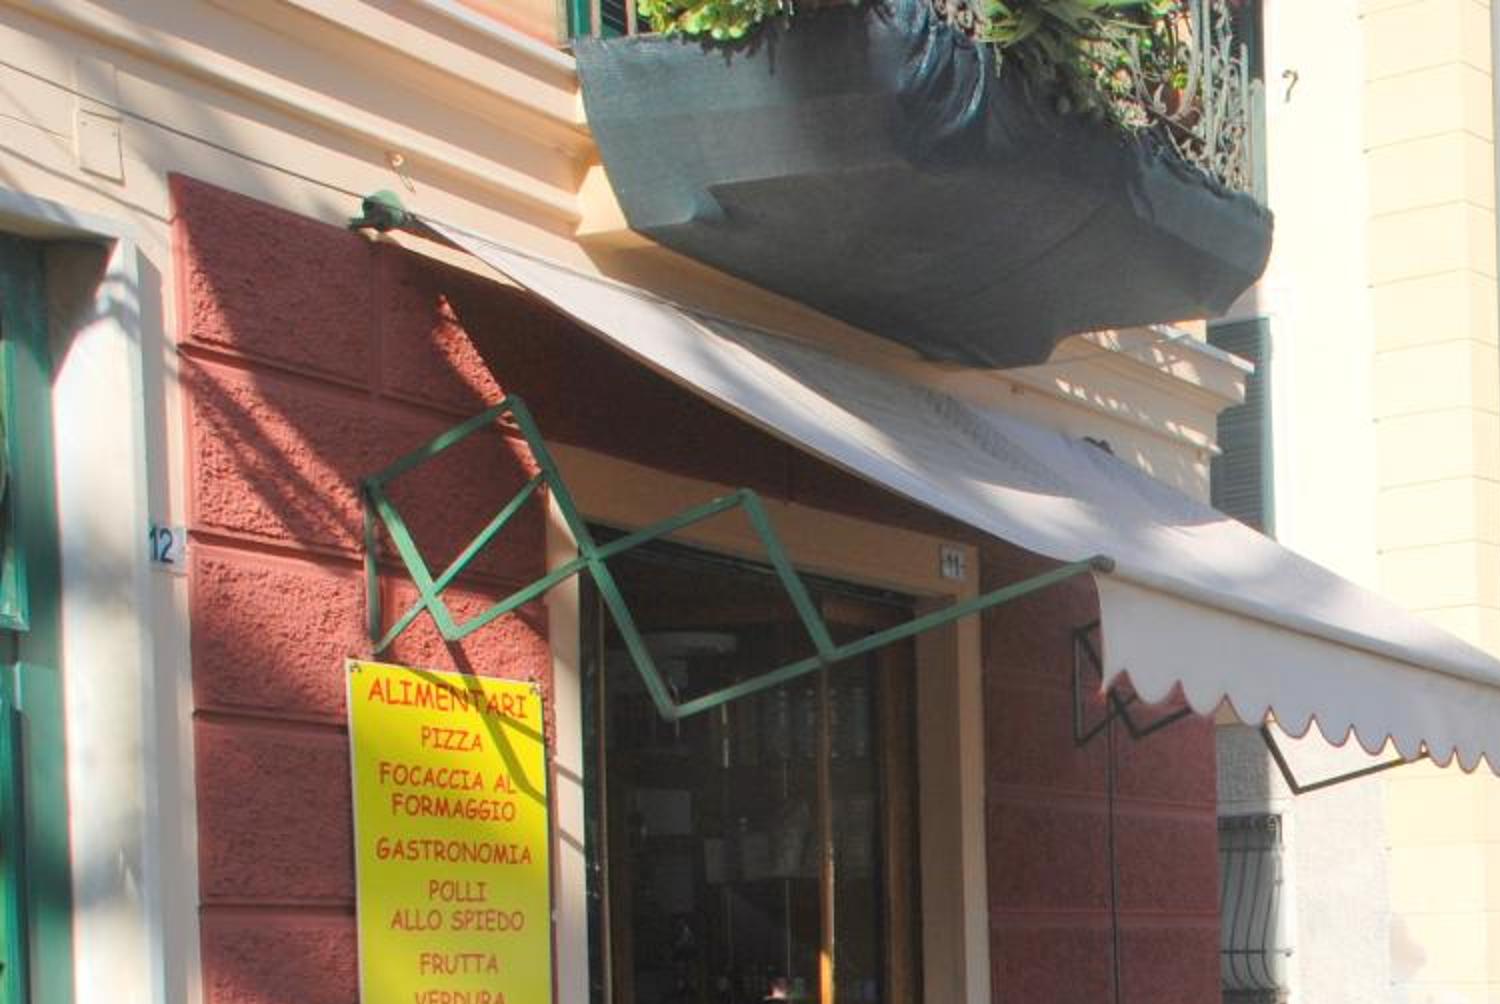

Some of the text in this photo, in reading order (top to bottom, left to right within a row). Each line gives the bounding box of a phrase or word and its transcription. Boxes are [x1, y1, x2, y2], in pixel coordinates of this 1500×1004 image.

[149, 526, 174, 564] 12
[368, 677, 528, 719] ALIMENTARI
[421, 725, 483, 752] PIZZA
[378, 762, 517, 795] FOCACCIA AL
[391, 793, 516, 822] FORMAGGIO
[376, 837, 532, 865] GASTRONOMIA
[429, 879, 488, 903] POLLI
[390, 908, 525, 932] ALLO SPIEDO
[419, 953, 498, 976] FRUTTA
